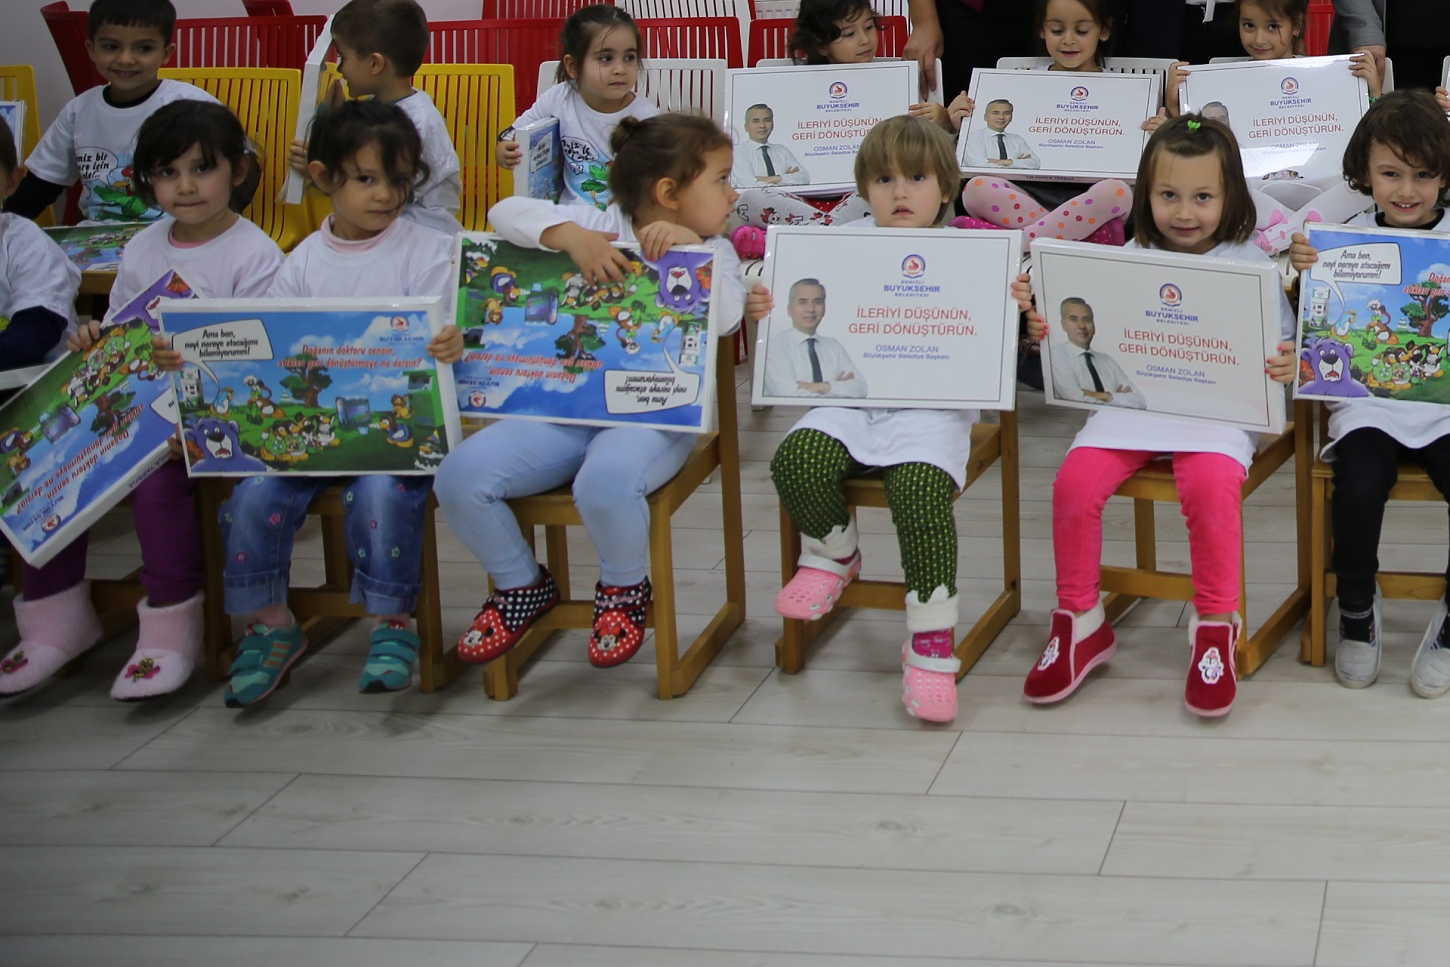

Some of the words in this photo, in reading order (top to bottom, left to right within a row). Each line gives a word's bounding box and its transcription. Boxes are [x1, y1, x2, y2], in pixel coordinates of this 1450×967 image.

[797, 119, 831, 129] İLERİYİ
[834, 117, 882, 128] DÜŞÜNÜN
[1035, 116, 1068, 125] İLERİYİ
[1070, 117, 1121, 127] DÜŞÜNÜN,
[1253, 116, 1286, 127] İLERİYİ
[1288, 112, 1338, 125] DÜŞÜNÜN,
[792, 131, 816, 141] GERİ
[1054, 126, 1125, 136] DÖNÜŞTÜRÜN.
[1248, 128, 1272, 139] GERİ
[1274, 123, 1344, 137] DÖNÜŞTÜRÜN.
[857, 306, 901, 319] İLERİYİ
[904, 307, 971, 322] DÜŞÜNÜN,
[202, 329, 218, 339] Ama
[221, 329, 235, 338] ben,
[848, 322, 880, 334] GERİ
[883, 322, 978, 338] DÖNÜŞTÜRÜN.
[185, 341, 199, 351] neyi
[201, 340, 224, 350] nereye
[1124, 327, 1165, 343] İLERİYİ
[1168, 333, 1232, 352] DÜŞÜNÜN,
[875, 344, 908, 352] OSMAN
[909, 345, 939, 353] ZOLAN
[1118, 342, 1147, 355] GERİ
[1150, 346, 1240, 366] DÖNÜŞTÜRÜN.
[1146, 364, 1176, 374] OSMAN
[1178, 368, 1205, 378] ZOLAN
